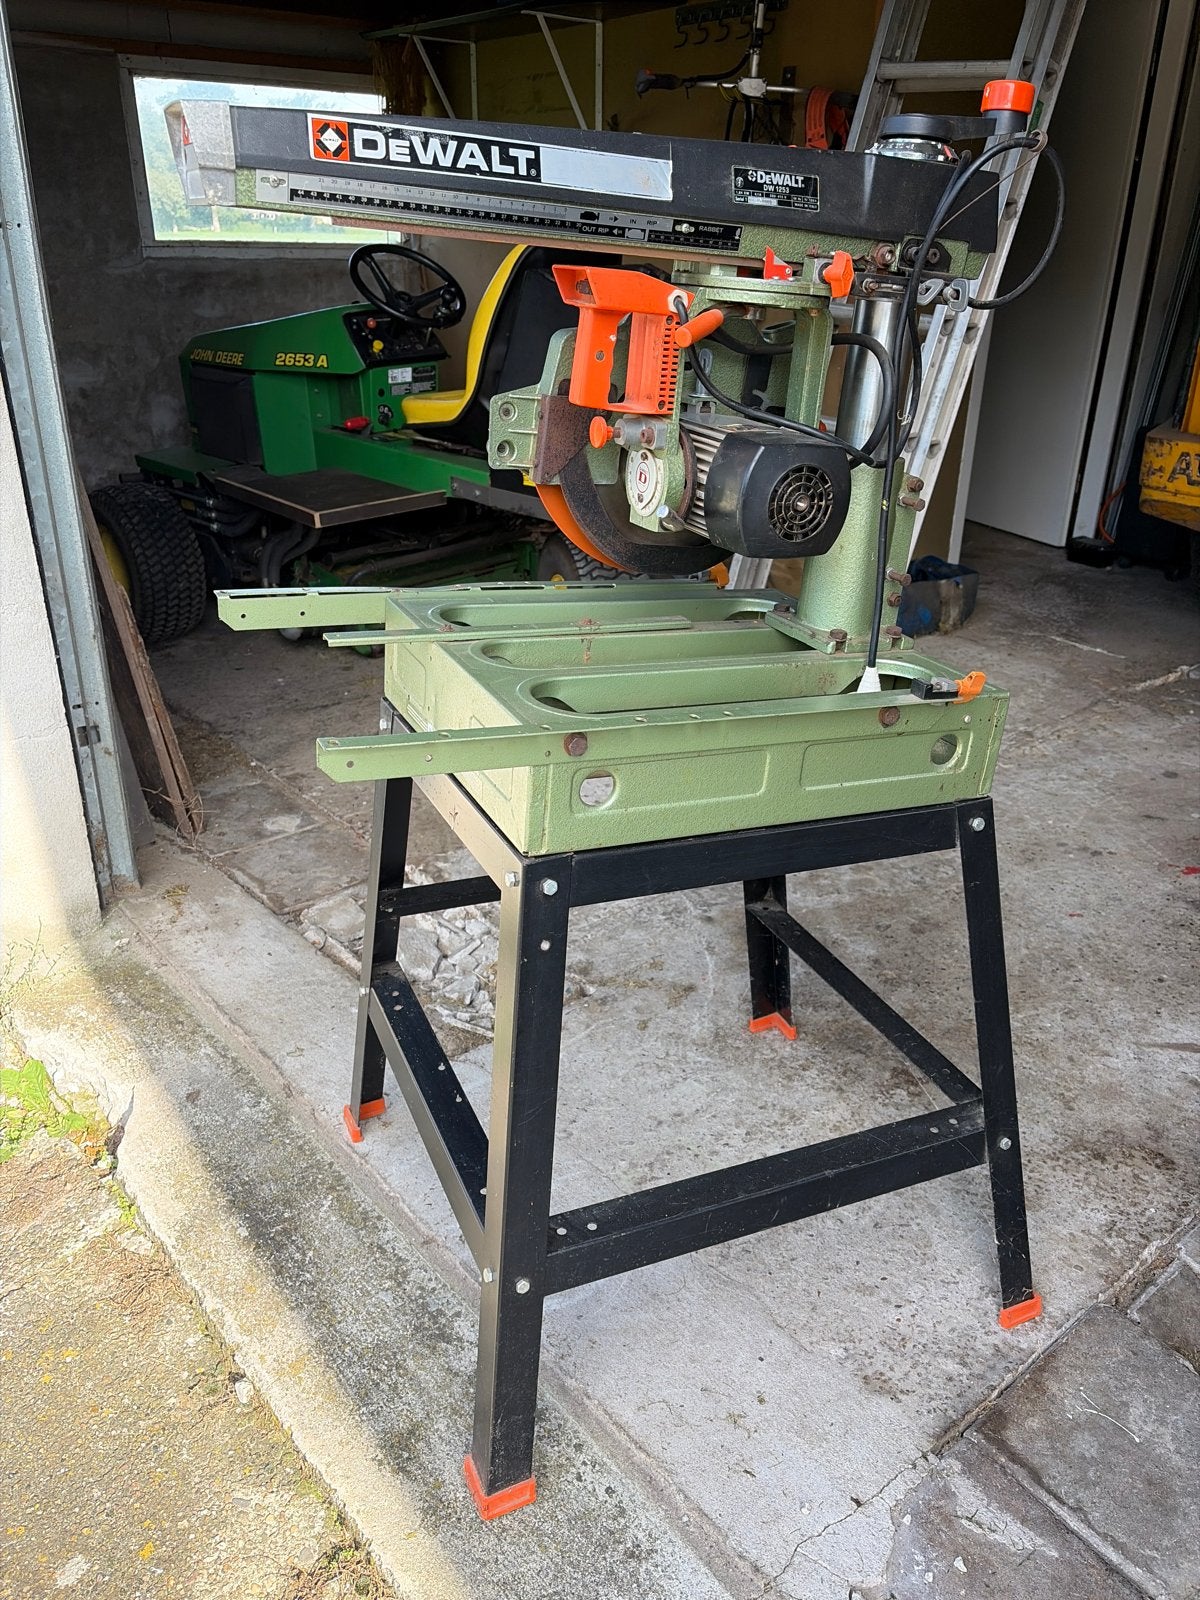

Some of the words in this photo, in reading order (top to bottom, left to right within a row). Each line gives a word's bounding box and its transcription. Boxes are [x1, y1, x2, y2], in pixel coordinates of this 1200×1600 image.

[763, 184, 775, 192] DW
[775, 186, 790, 194] 1253
[581, 225, 596, 233] OUT
[699, 225, 724, 233] RABBET
[190, 349, 214, 362] JOHN
[215, 351, 244, 365] DEERE
[275, 352, 315, 367] 2653
[316, 354, 328, 368] A
